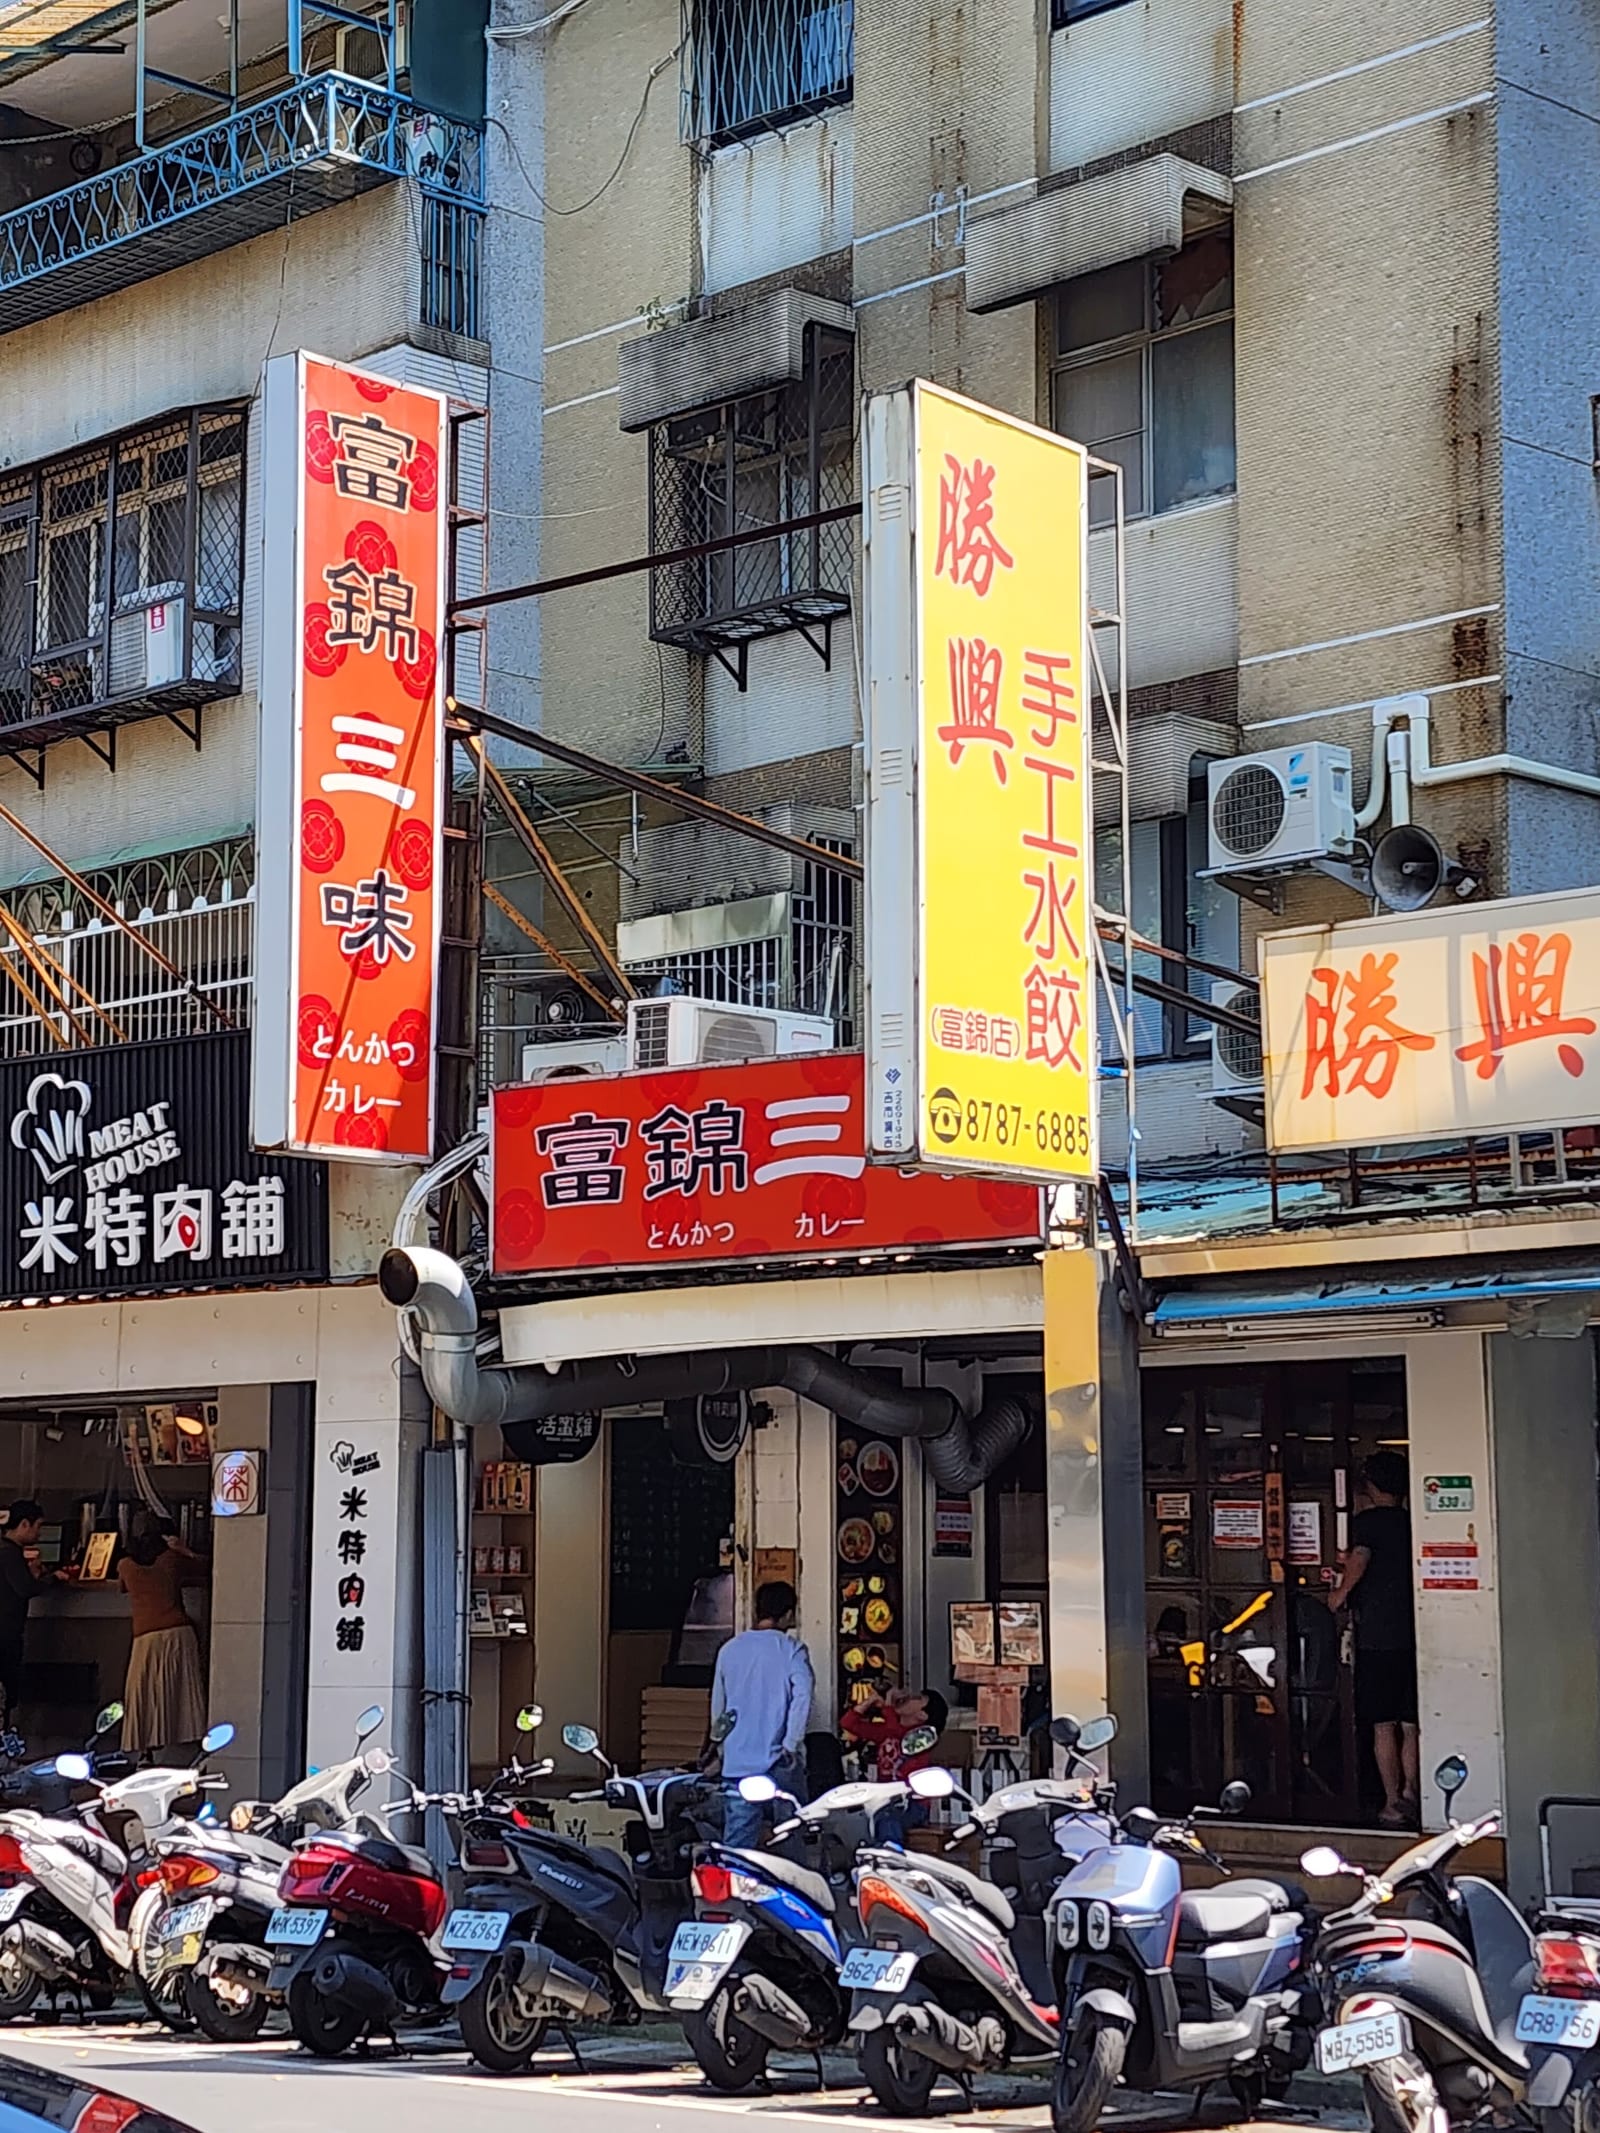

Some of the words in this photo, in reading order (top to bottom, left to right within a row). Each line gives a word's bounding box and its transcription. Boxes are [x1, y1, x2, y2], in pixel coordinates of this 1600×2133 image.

[935, 453, 1013, 785] 勝興
[321, 411, 418, 964] 富錦三味
[1021, 651, 1082, 1072] 手工水餃
[311, 1026, 416, 1066] とんかつ
[1300, 931, 1597, 1100] 勝興
[88, 1101, 170, 1158] MEAT
[323, 1079, 402, 1114] カレー
[966, 1099, 1090, 1156] 8787-6885
[83, 1130, 181, 1194] HOUSE
[534, 1094, 866, 1208] 富錦三
[19, 1176, 285, 1273] 米特肉舖
[646, 1222, 735, 1249] とんかつ
[793, 1211, 865, 1239] カレー
[336, 1486, 368, 1651] 米特肉舖
